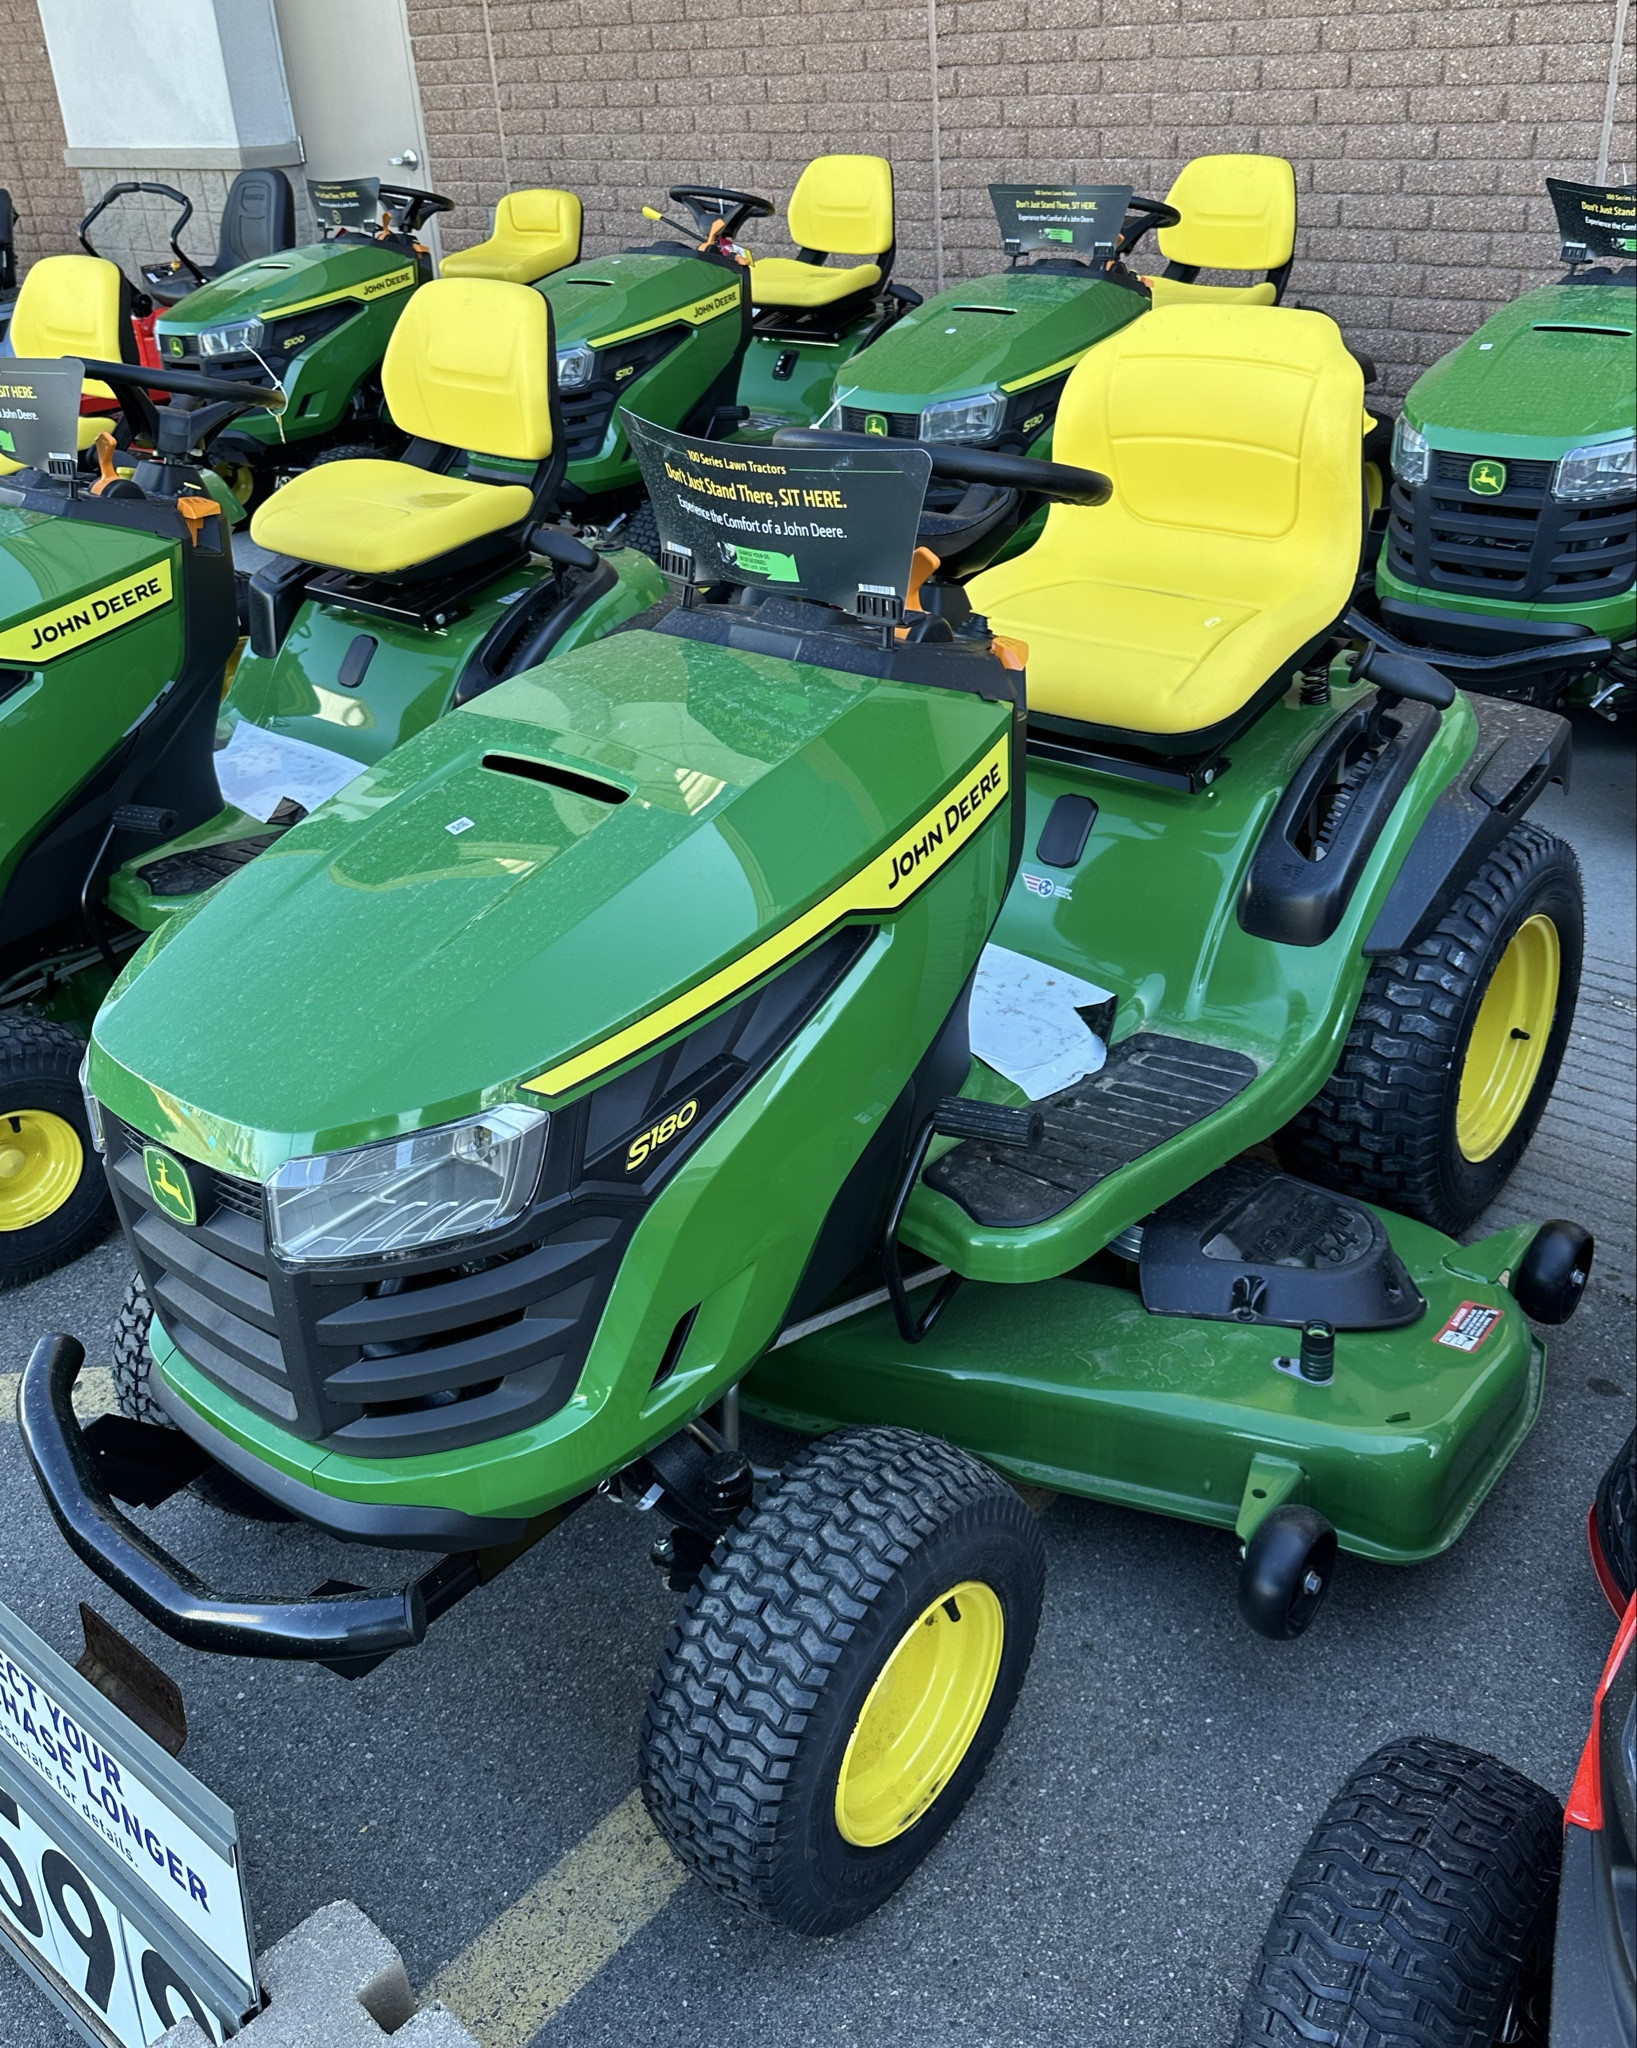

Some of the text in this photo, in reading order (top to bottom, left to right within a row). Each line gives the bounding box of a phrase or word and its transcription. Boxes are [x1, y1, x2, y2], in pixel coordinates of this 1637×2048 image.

[1581, 201, 1636, 216] Don't Just Stand
[364, 272, 411, 295] JOHN DEERE
[694, 292, 737, 318] JOHN DEERE
[2, 408, 17, 419] John
[17, 409, 39, 420] Deere.
[11, 386, 37, 399] HERE.
[687, 450, 786, 474] 100 Series Lawn Tractors
[664, 462, 848, 508] Don't Just Stand There, SIT HERE.
[677, 494, 847, 538] Experience the Comfort of a John Deere.
[31, 578, 162, 650] JOHN DEERE
[888, 762, 1001, 890] JOHN DEERE
[626, 1100, 697, 1171] S180
[44, 1694, 124, 1797] YOUR
[0, 1684, 211, 1914] HASE LONGER
[56, 1775, 76, 1804] for
[82, 1804, 138, 1868] details.
